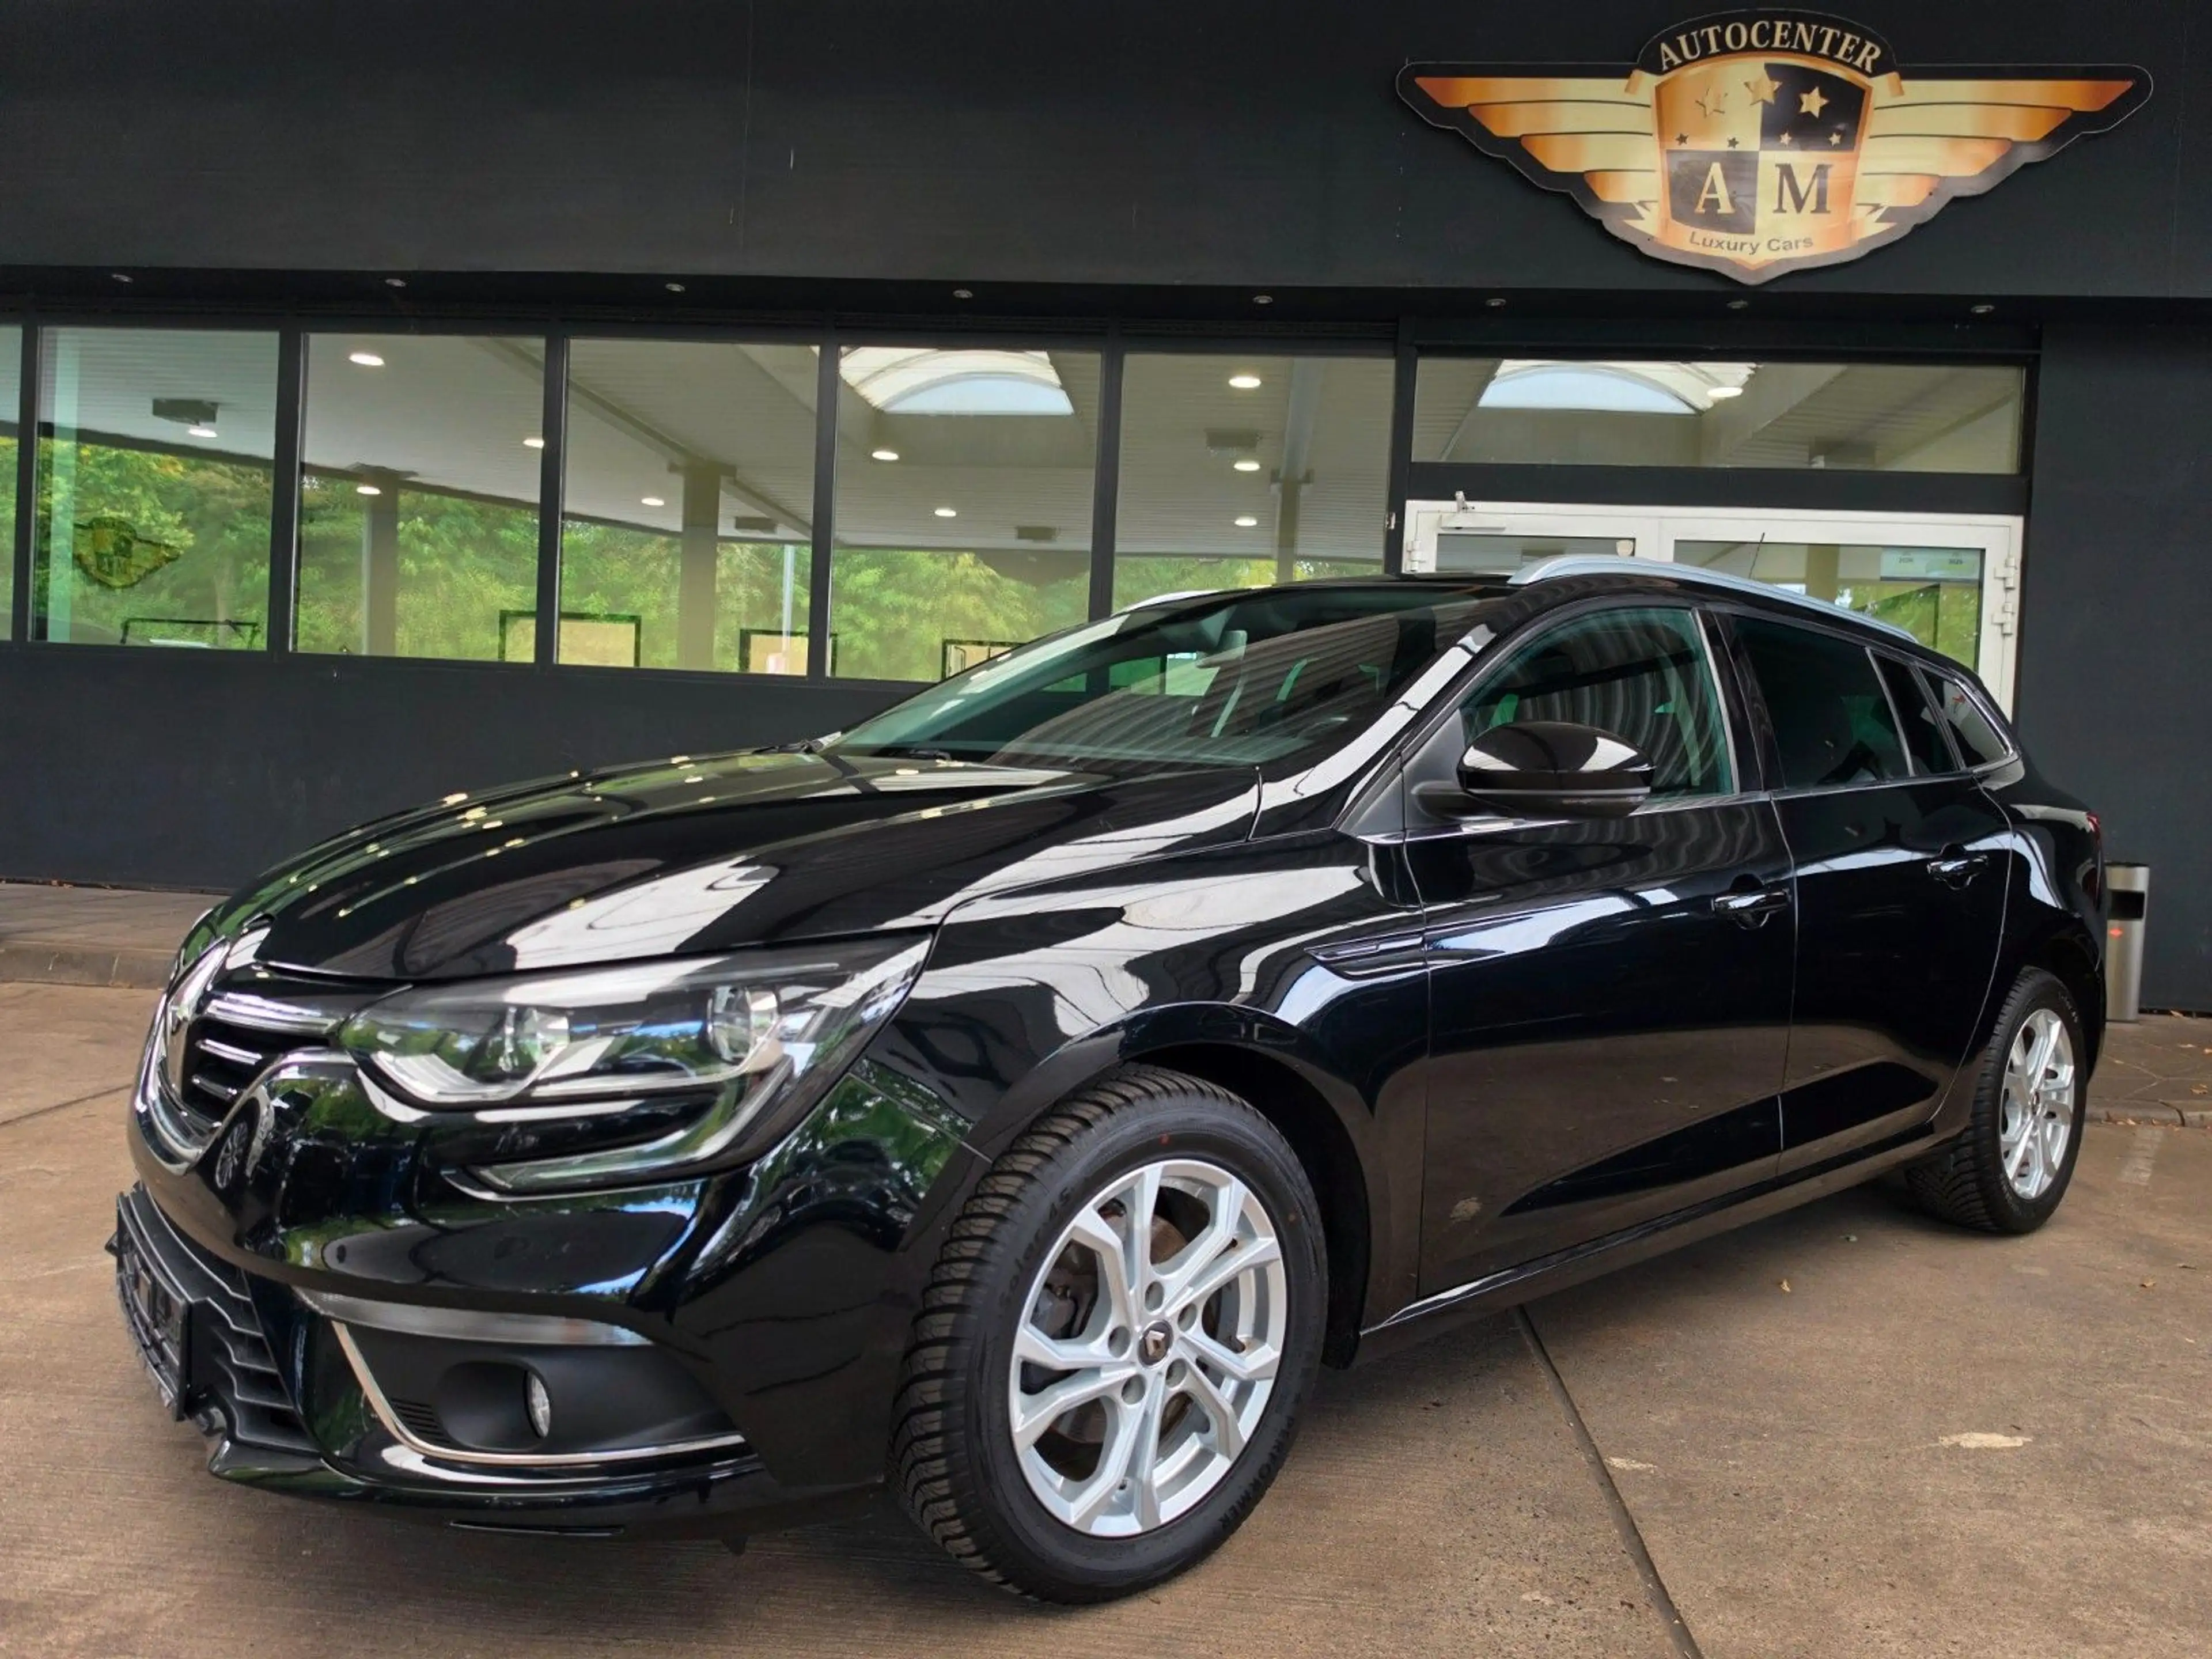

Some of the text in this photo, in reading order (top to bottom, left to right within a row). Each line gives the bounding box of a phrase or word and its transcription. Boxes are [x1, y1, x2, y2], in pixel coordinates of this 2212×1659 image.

[1660, 20, 1882, 73] AUTOCENTER
[1694, 162, 1833, 214] A M
[1690, 231, 1814, 255] Luxury Cars
